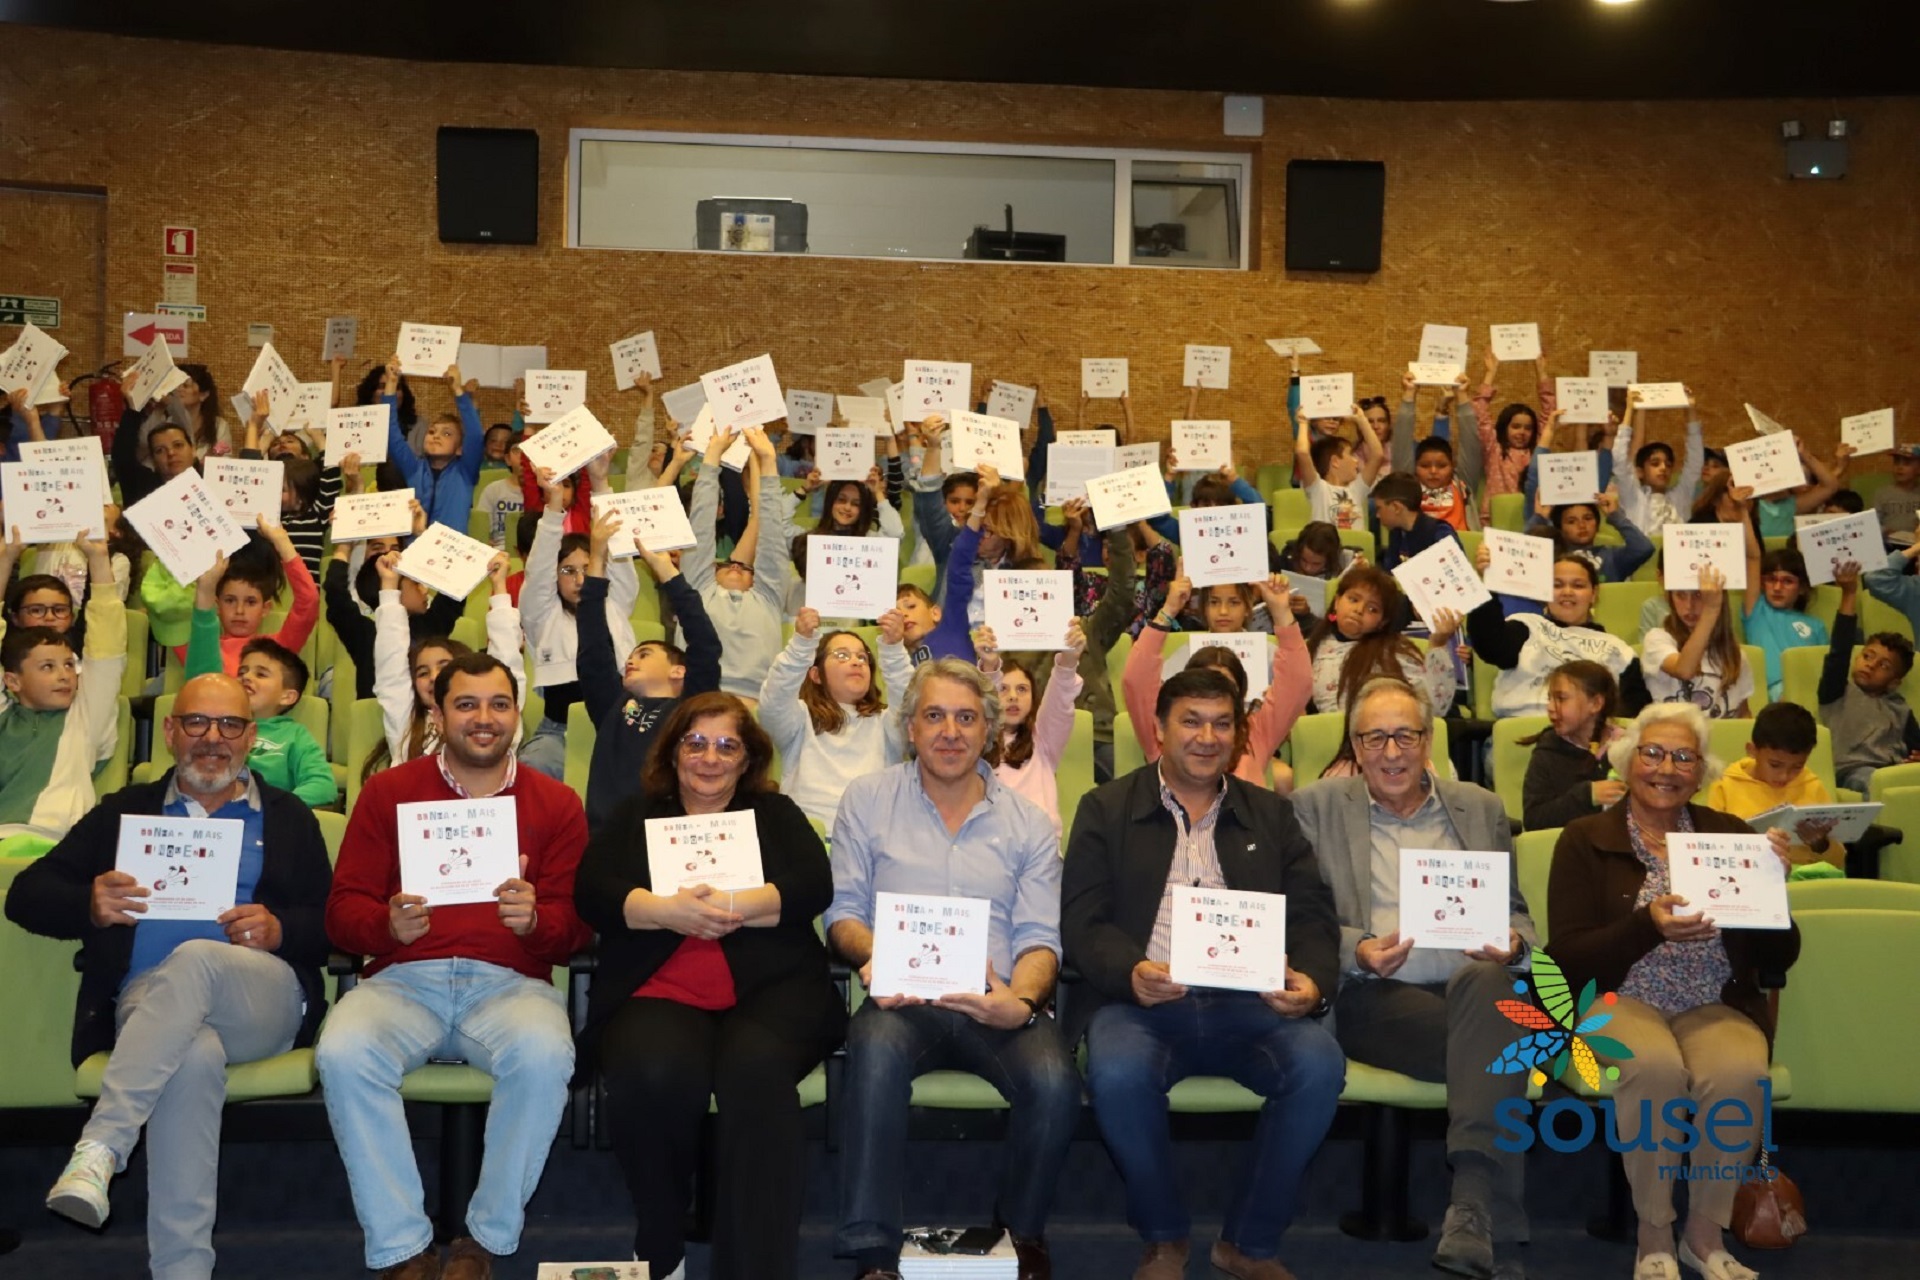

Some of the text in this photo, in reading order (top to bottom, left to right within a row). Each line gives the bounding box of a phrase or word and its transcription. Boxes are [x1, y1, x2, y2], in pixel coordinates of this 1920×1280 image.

[497, 500, 525, 512] OUT
[467, 808, 495, 818] MAIS
[709, 818, 736, 828] MAIS
[192, 828, 222, 839] MAIS
[1733, 842, 1761, 851] MAIS
[1463, 860, 1490, 870] MAIS
[1238, 899, 1266, 911] MAIS
[942, 906, 970, 917] MAIS
